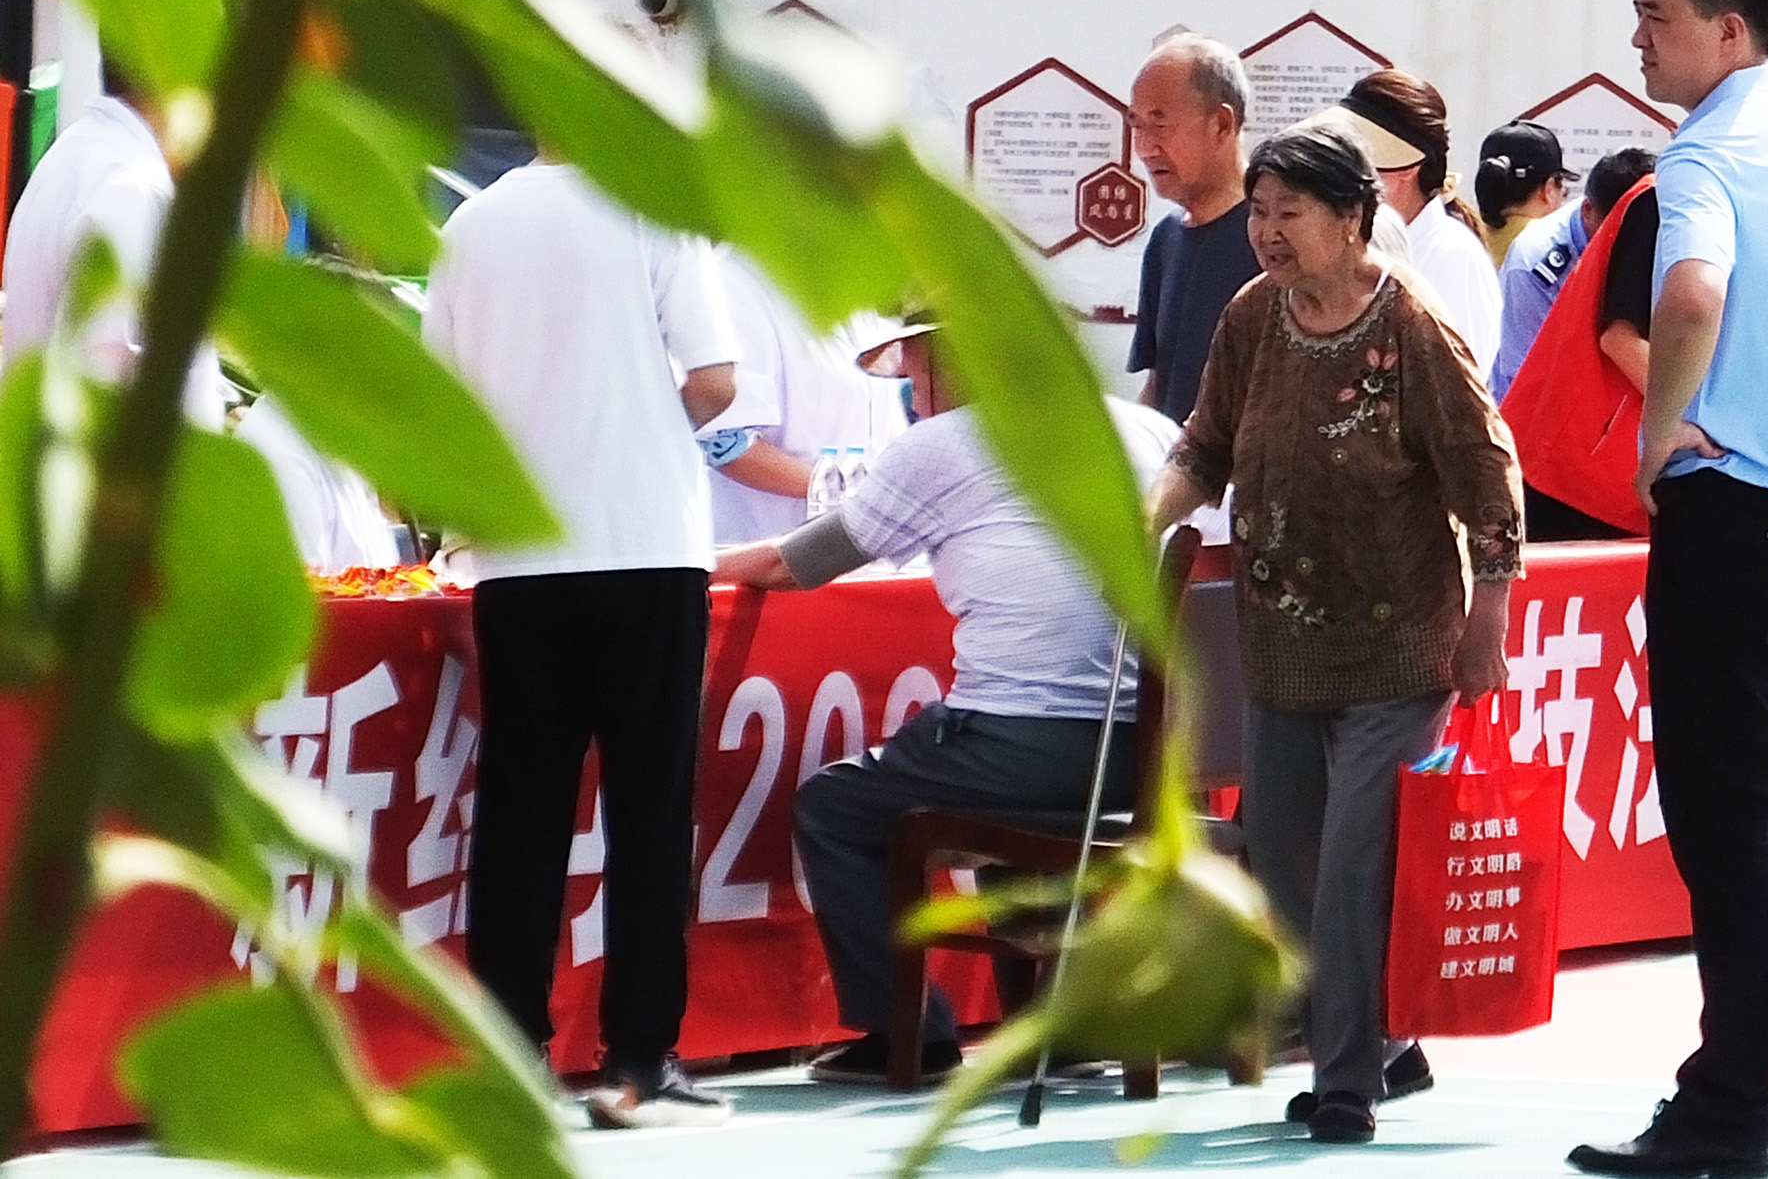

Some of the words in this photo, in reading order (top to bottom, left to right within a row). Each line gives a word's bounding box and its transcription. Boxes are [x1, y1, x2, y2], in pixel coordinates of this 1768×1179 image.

[1450, 817, 1519, 842] 说文明话
[1447, 852, 1522, 876] 行文明路
[1446, 887, 1521, 911] 办文明事
[1443, 922, 1519, 947] 做文明人
[1440, 956, 1516, 979] 建文明城
